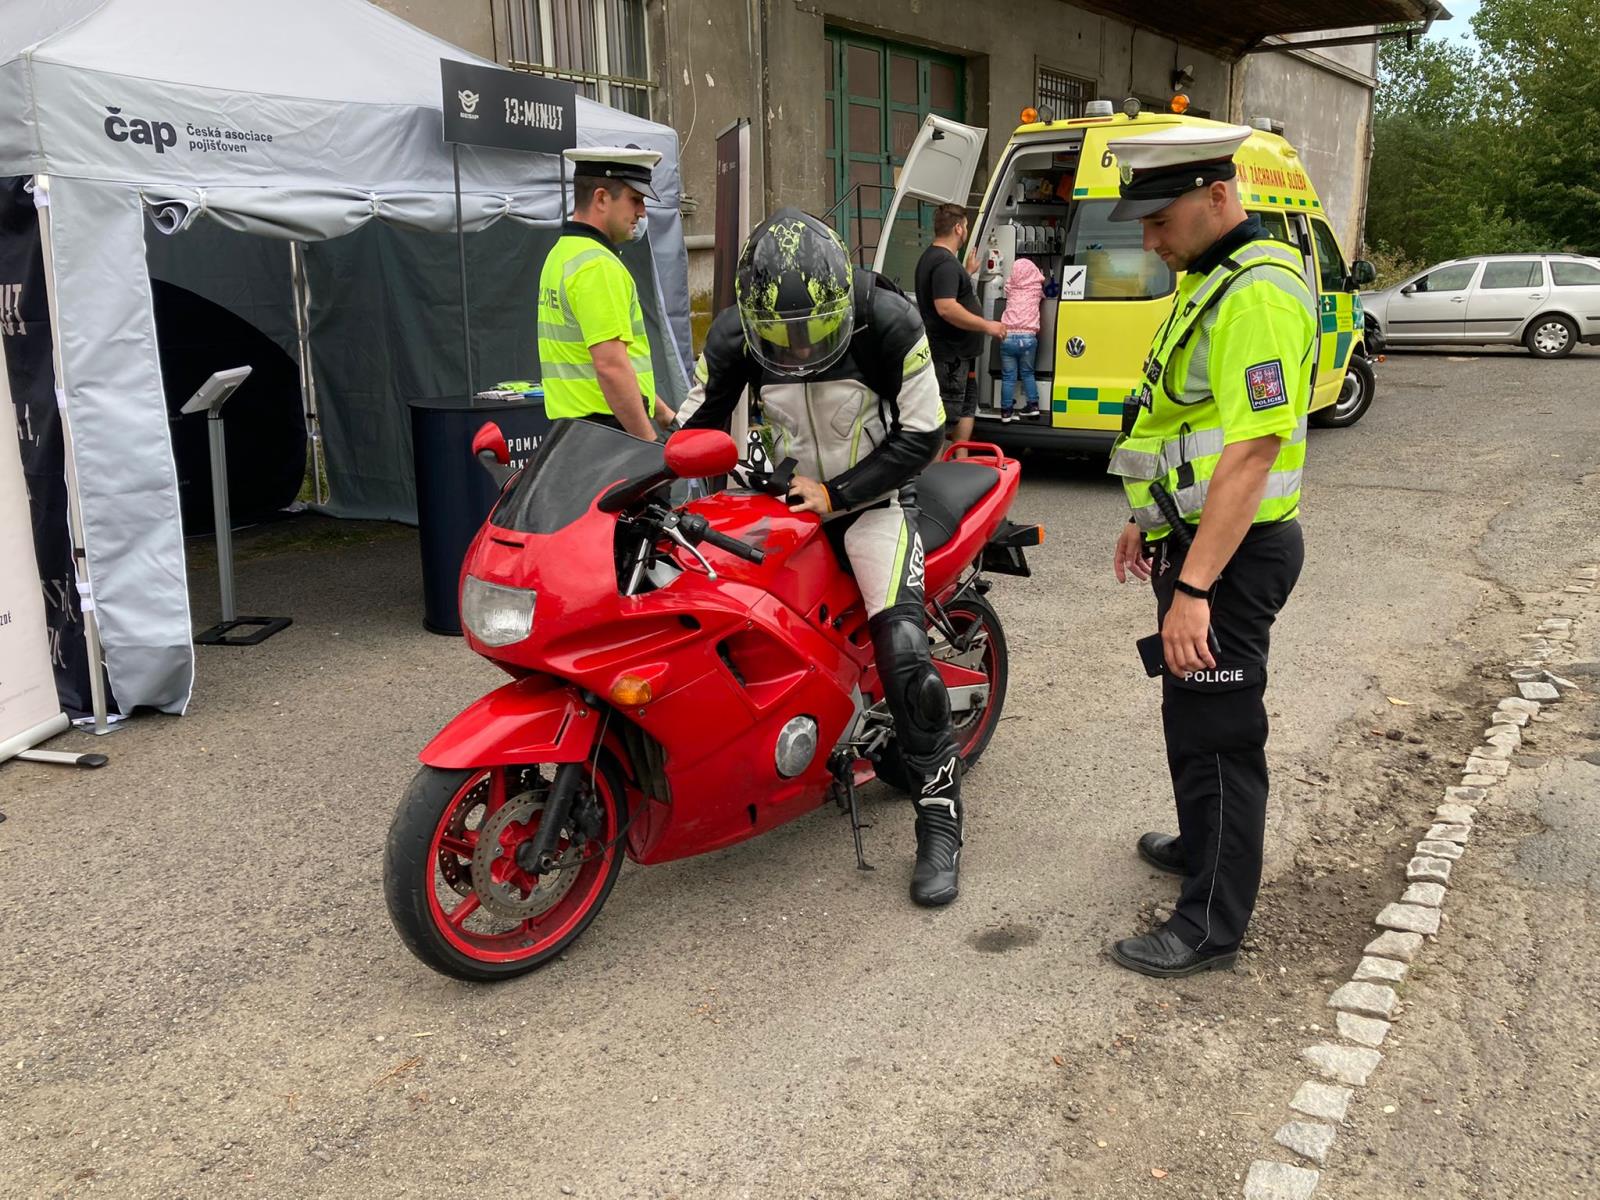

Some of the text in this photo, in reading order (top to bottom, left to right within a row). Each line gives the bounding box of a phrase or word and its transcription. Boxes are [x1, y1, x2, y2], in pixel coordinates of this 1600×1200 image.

[104, 106, 177, 154] čap
[186, 122, 273, 142] Česká asociace
[189, 138, 247, 152] pojišťoven
[1254, 396, 1282, 407] POLICIE
[508, 435, 542, 453] POMA
[1184, 669, 1244, 683] POLICIE
